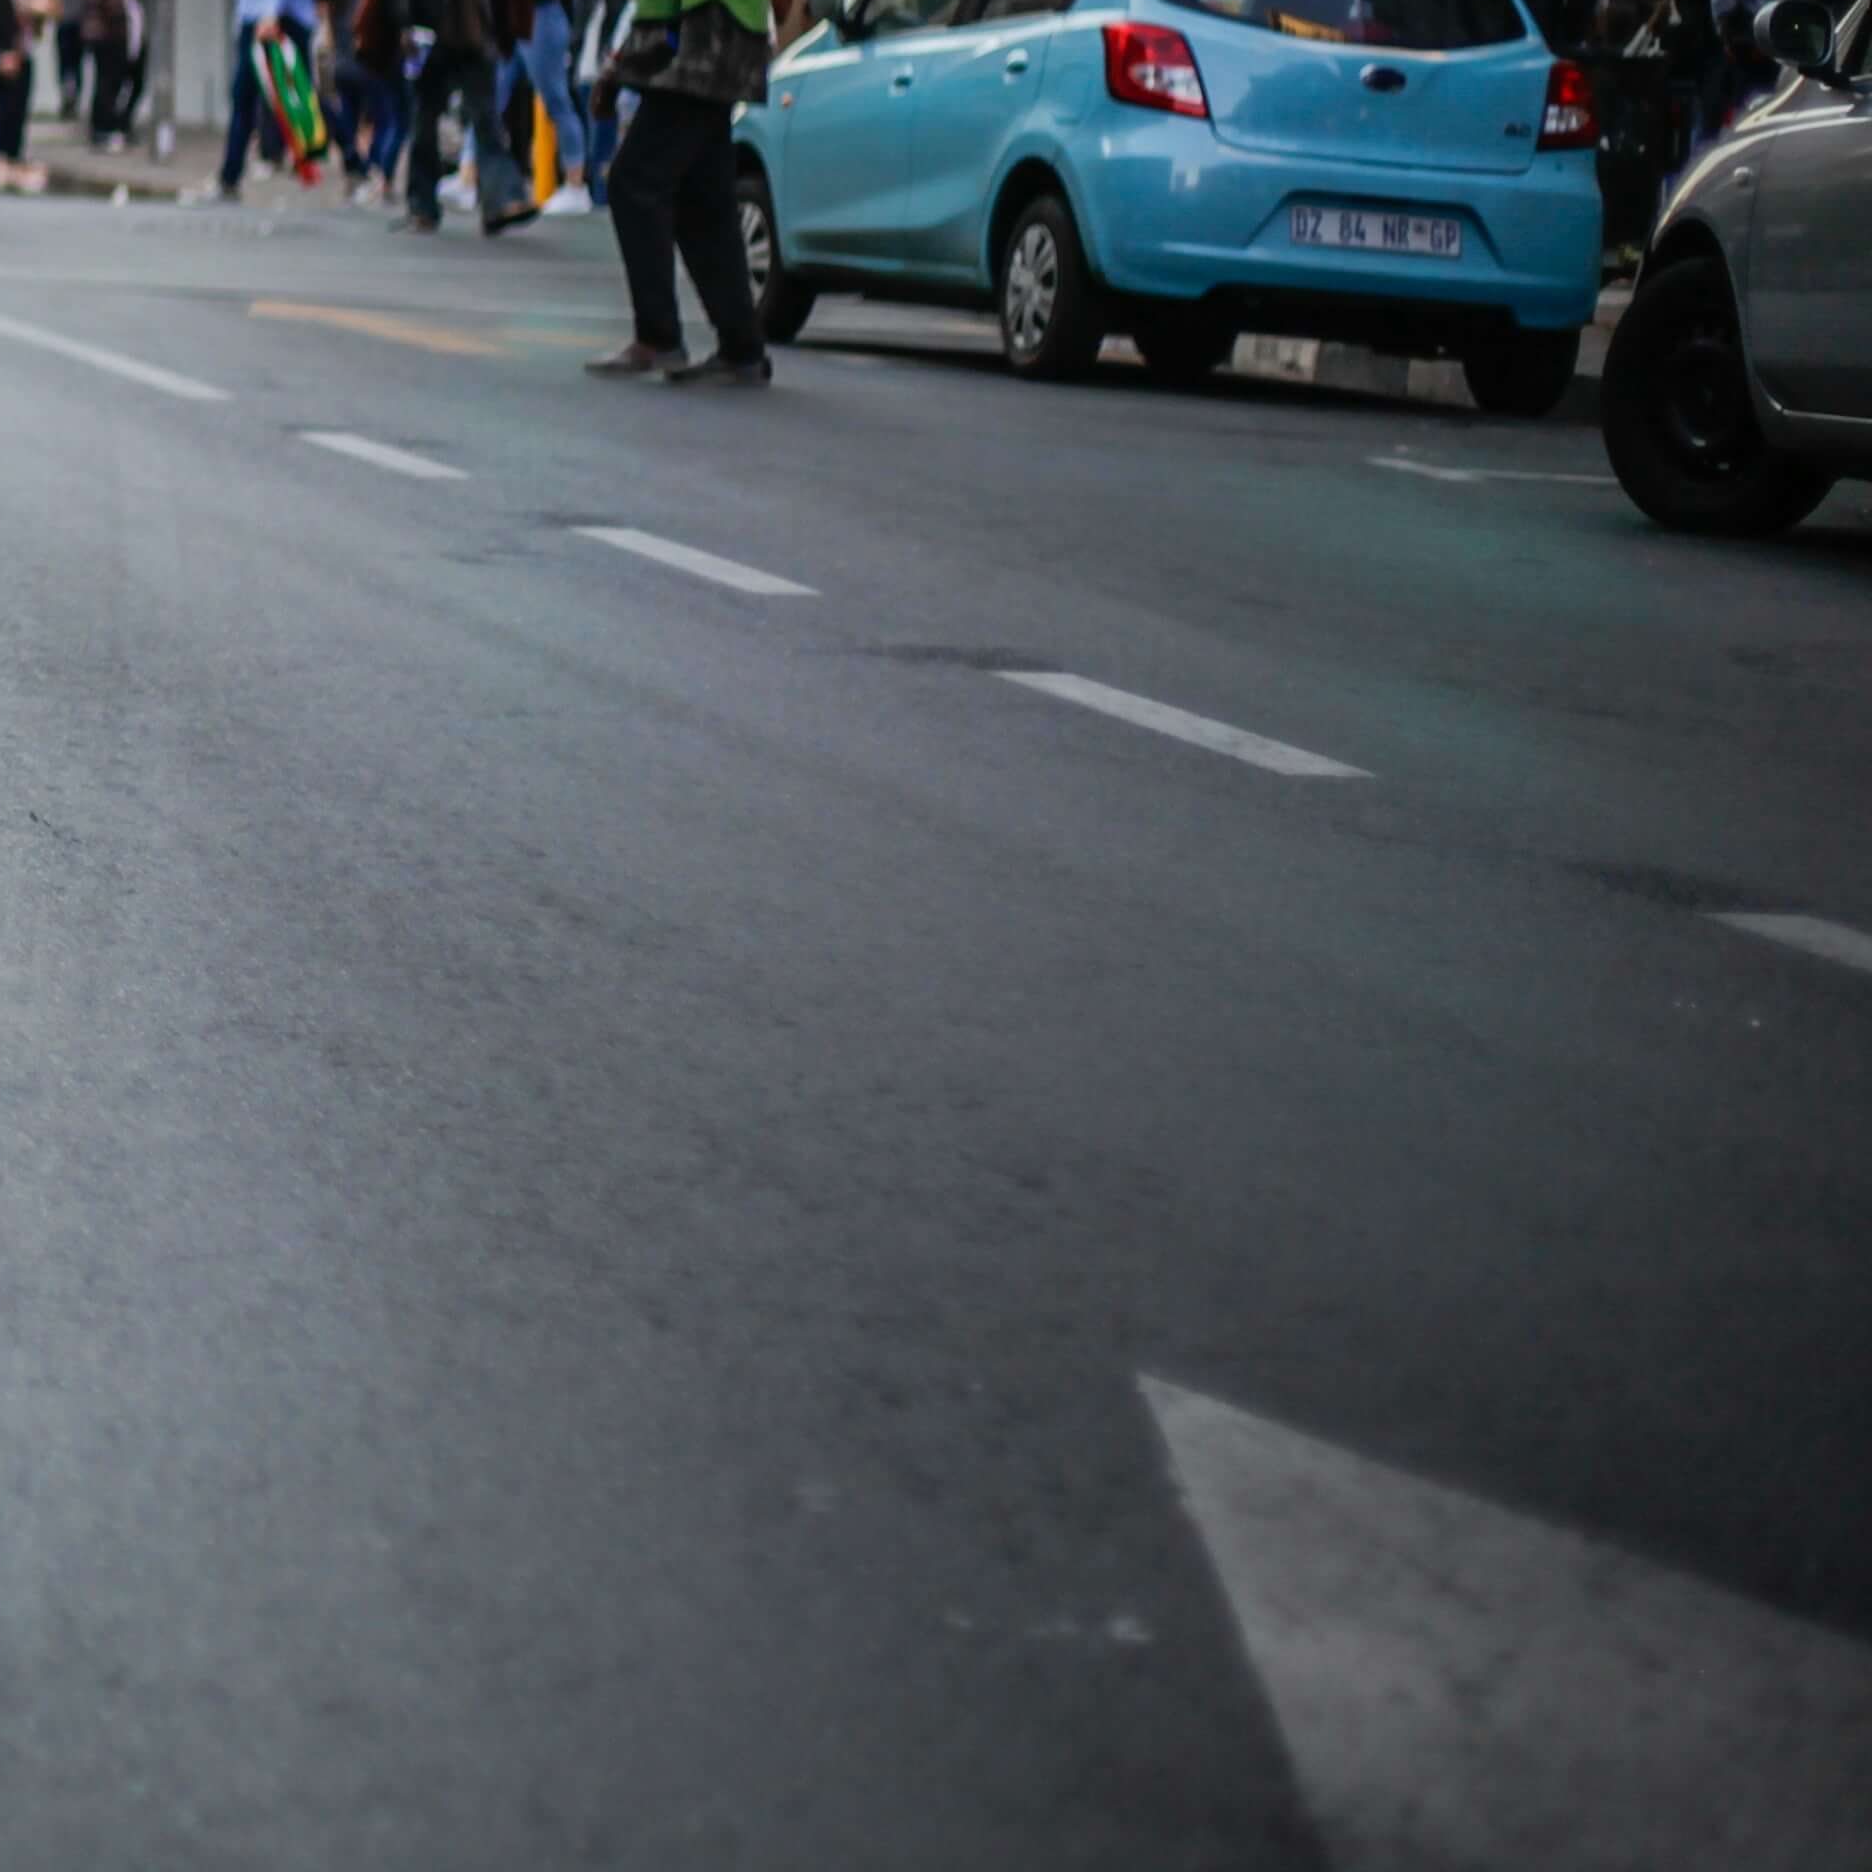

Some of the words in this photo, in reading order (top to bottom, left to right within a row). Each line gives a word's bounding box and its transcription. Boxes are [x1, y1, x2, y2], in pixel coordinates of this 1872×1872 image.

[1295, 207, 1323, 242] DZ
[1340, 212, 1366, 245] 84
[1382, 216, 1410, 249] NR
[1430, 221, 1458, 252] GP
